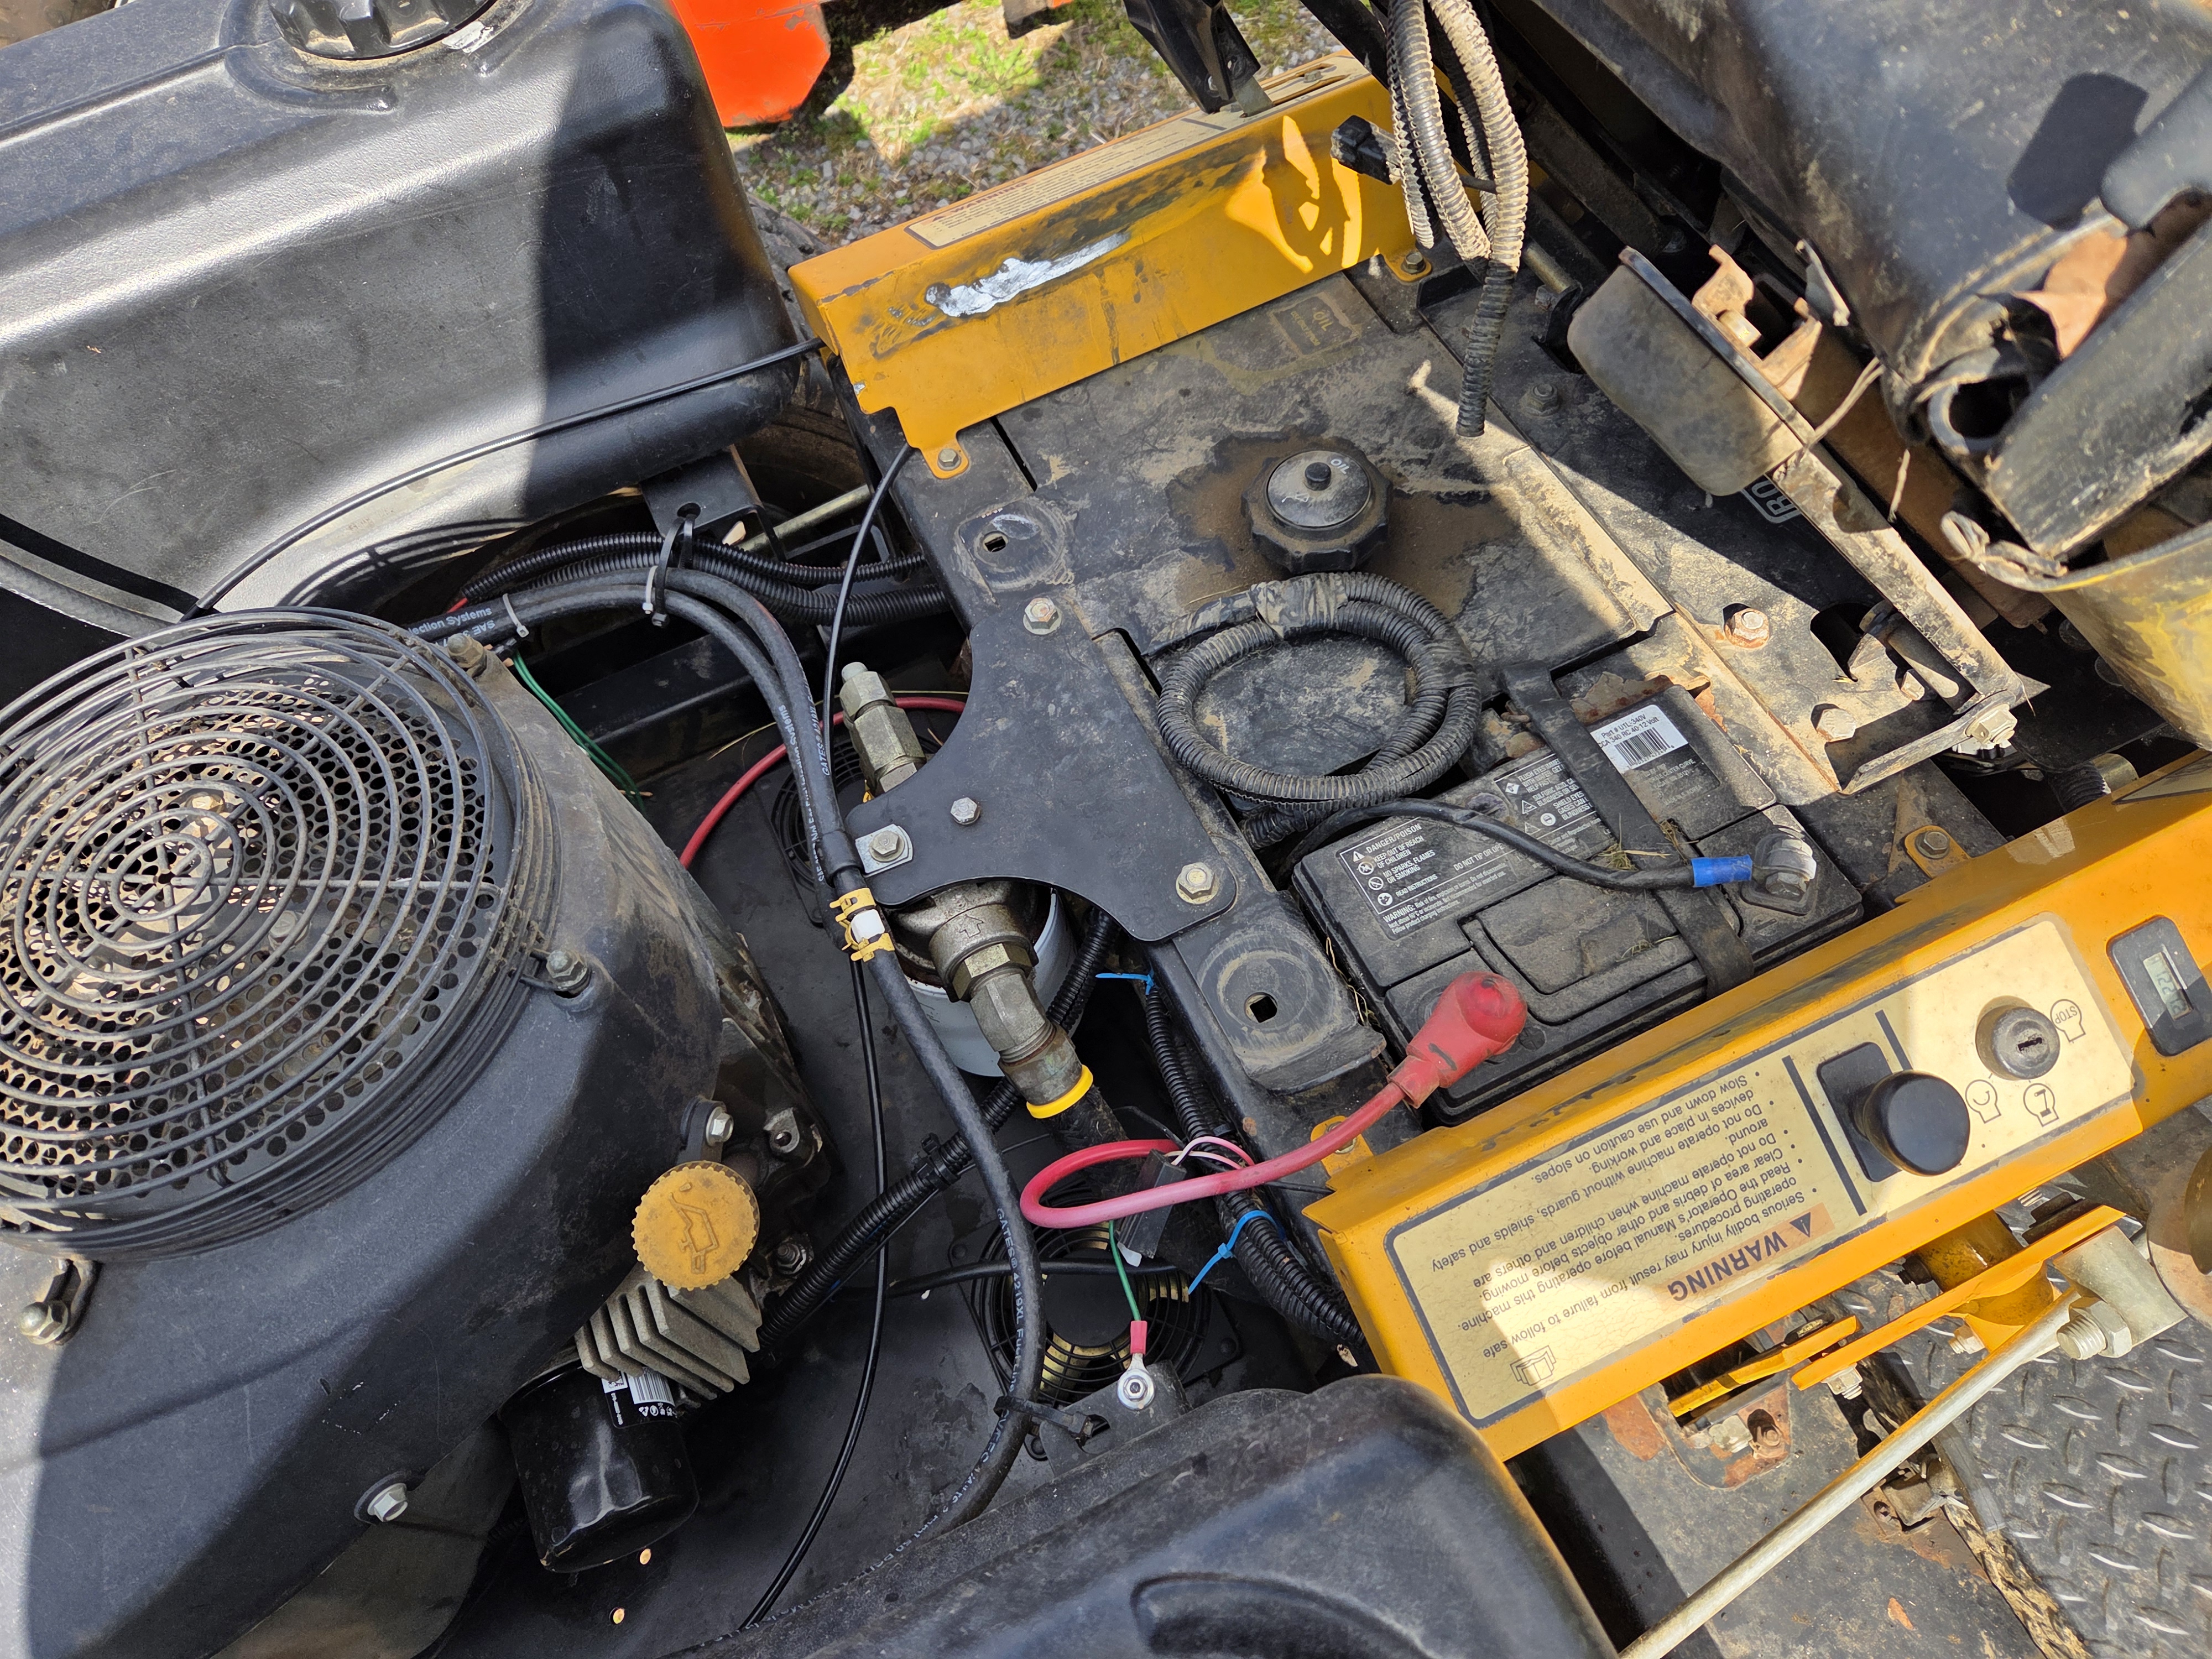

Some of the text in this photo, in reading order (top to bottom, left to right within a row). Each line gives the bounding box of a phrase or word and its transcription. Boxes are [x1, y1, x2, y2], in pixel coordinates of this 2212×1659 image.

[1312, 307, 1335, 333] OIL
[1331, 458, 1349, 474] OIL
[445, 606, 494, 628] Systems
[471, 619, 497, 636] SAE
[1601, 728, 1615, 739] Part
[1609, 733, 1623, 744] 340
[1620, 728, 1632, 738] RC
[1647, 715, 1660, 726] Volt
[1517, 770, 1535, 783] FLUSH
[1532, 764, 1547, 776] EYES
[1521, 776, 1537, 789] WITH
[1551, 764, 1563, 775] GET
[1525, 782, 1541, 794] HELP
[1532, 785, 1556, 802] SULFURIC
[1536, 789, 1564, 808] BLINDNESS
[1561, 786, 1572, 796] OR
[1552, 789, 1585, 810] SHIELD EYES
[1557, 796, 1587, 816] GASES CAN
[1561, 802, 1591, 822] BLINDNESS
[1365, 822, 1423, 855] DANGER/POISON
[1372, 833, 1426, 865] KEEP OUT OF REACH
[1376, 847, 1413, 870] OF CHILDREN
[1383, 848, 1437, 880] NO SPARKS, FLAMES
[1452, 860, 1464, 872] DO
[1461, 855, 1476, 868] NOT
[1473, 852, 1484, 863] TIP
[1482, 847, 1494, 858] OR
[1386, 863, 1422, 885] OR SMOKING
[1395, 873, 1439, 899] READ INSTRUCTIONS
[1383, 902, 1417, 925] WARNING:
[2052, 1004, 2079, 1025] STOP
[1531, 1074, 1748, 1183] Slow down and use caution on slopes.
[1588, 1089, 1754, 1174] devices in place and working.
[1725, 1118, 1768, 1146] around.
[1432, 1103, 1762, 1272] Do not operate machine without guards, shields and safety
[1473, 1133, 1777, 1288] Do not operate machine when children and others are
[1674, 1177, 1797, 1241] operating procedures.
[1479, 1148, 1783, 1302] Clear area of debris and other objects before mowing.
[1458, 1161, 1791, 1331] Read the Operator's Manual before operating this machine.
[1483, 1191, 1805, 1358] Serious bodily injury may result from failure to follow safe
[1667, 1231, 1788, 1301] WARNING
[1005, 1271, 1029, 1325] 4219XL
